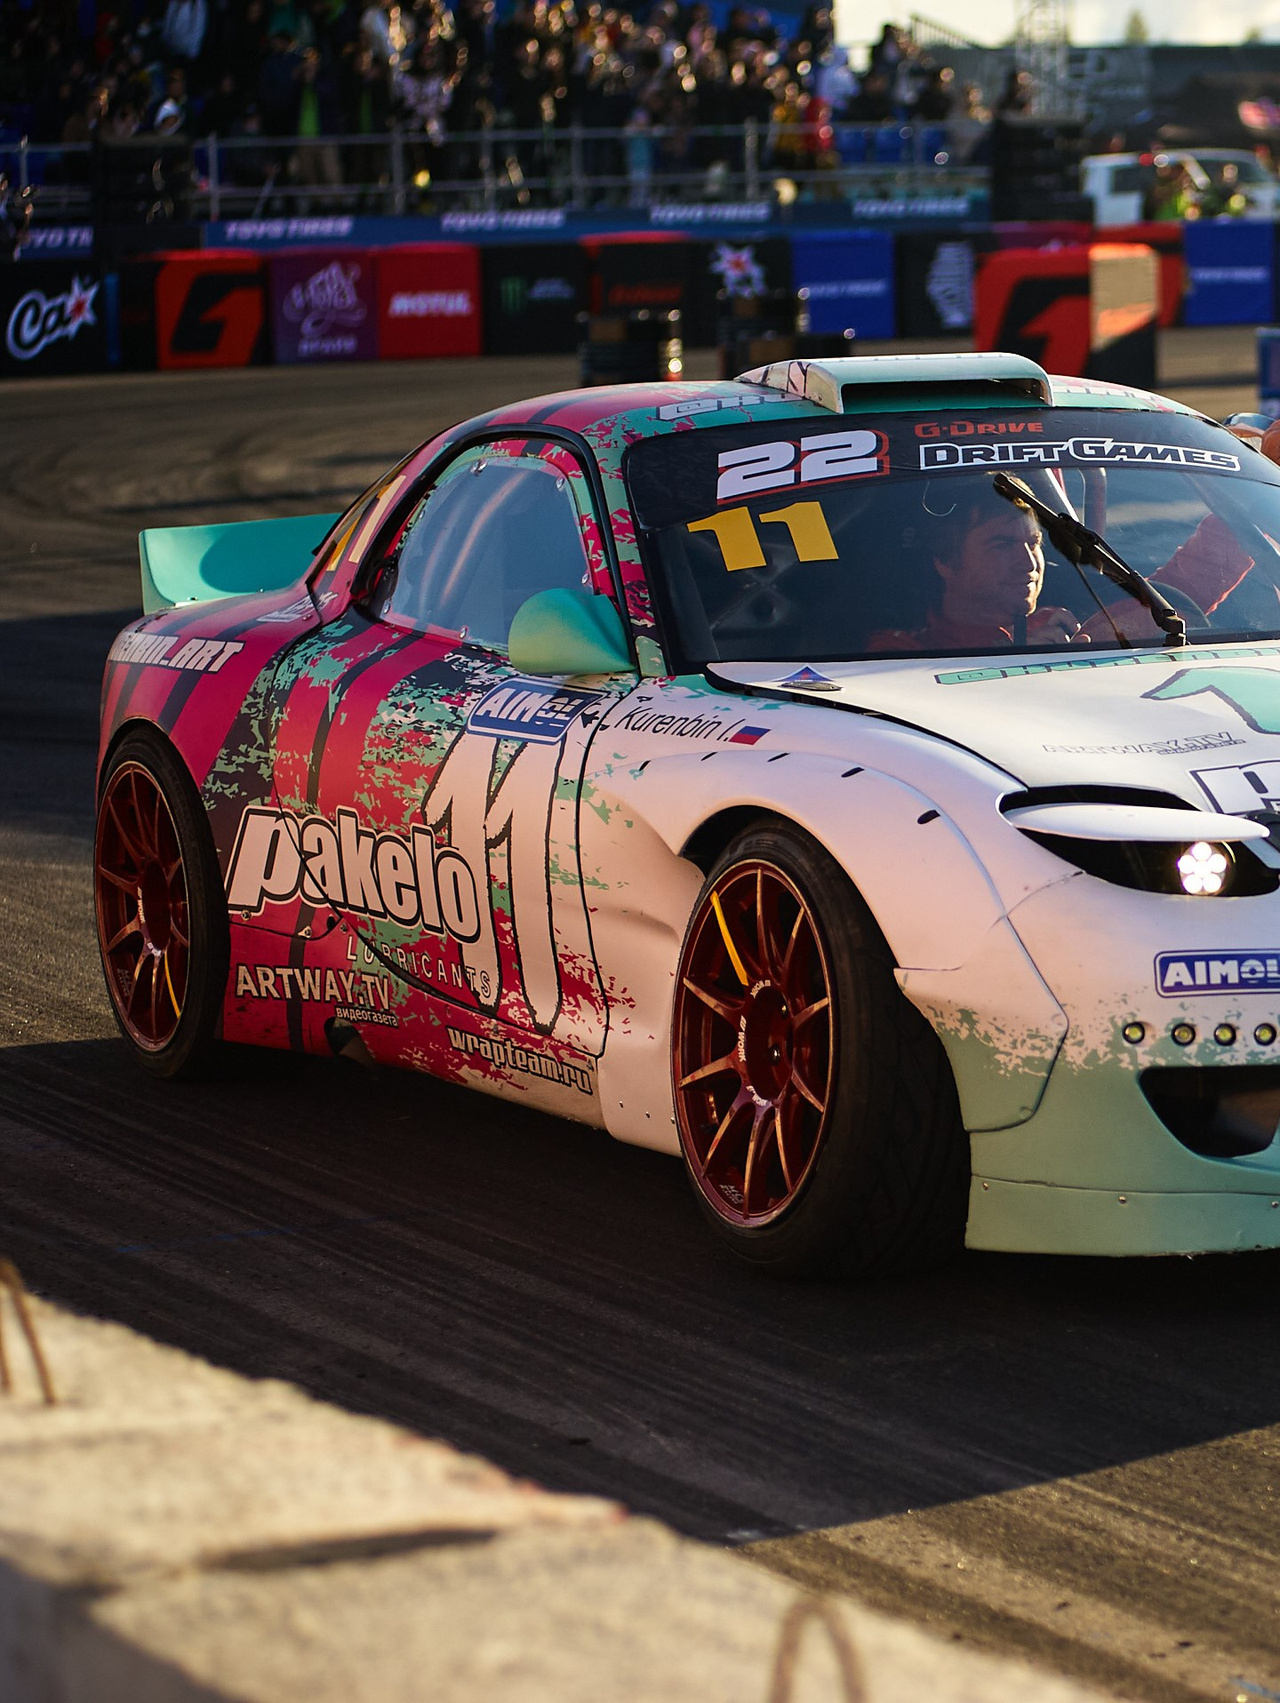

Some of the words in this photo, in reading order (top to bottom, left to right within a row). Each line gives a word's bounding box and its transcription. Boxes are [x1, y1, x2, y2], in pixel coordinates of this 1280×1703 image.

[716, 429, 886, 503] 22
[686, 501, 839, 571] 11
[614, 706, 718, 740] Kurenbin
[224, 806, 482, 944] pakelo
[235, 964, 390, 1011] ARTWAY.TV
[346, 935, 493, 998] LUBRICANTS
[335, 1006, 398, 1026] видеогазета
[445, 1025, 594, 1095] wrapteam.ru
